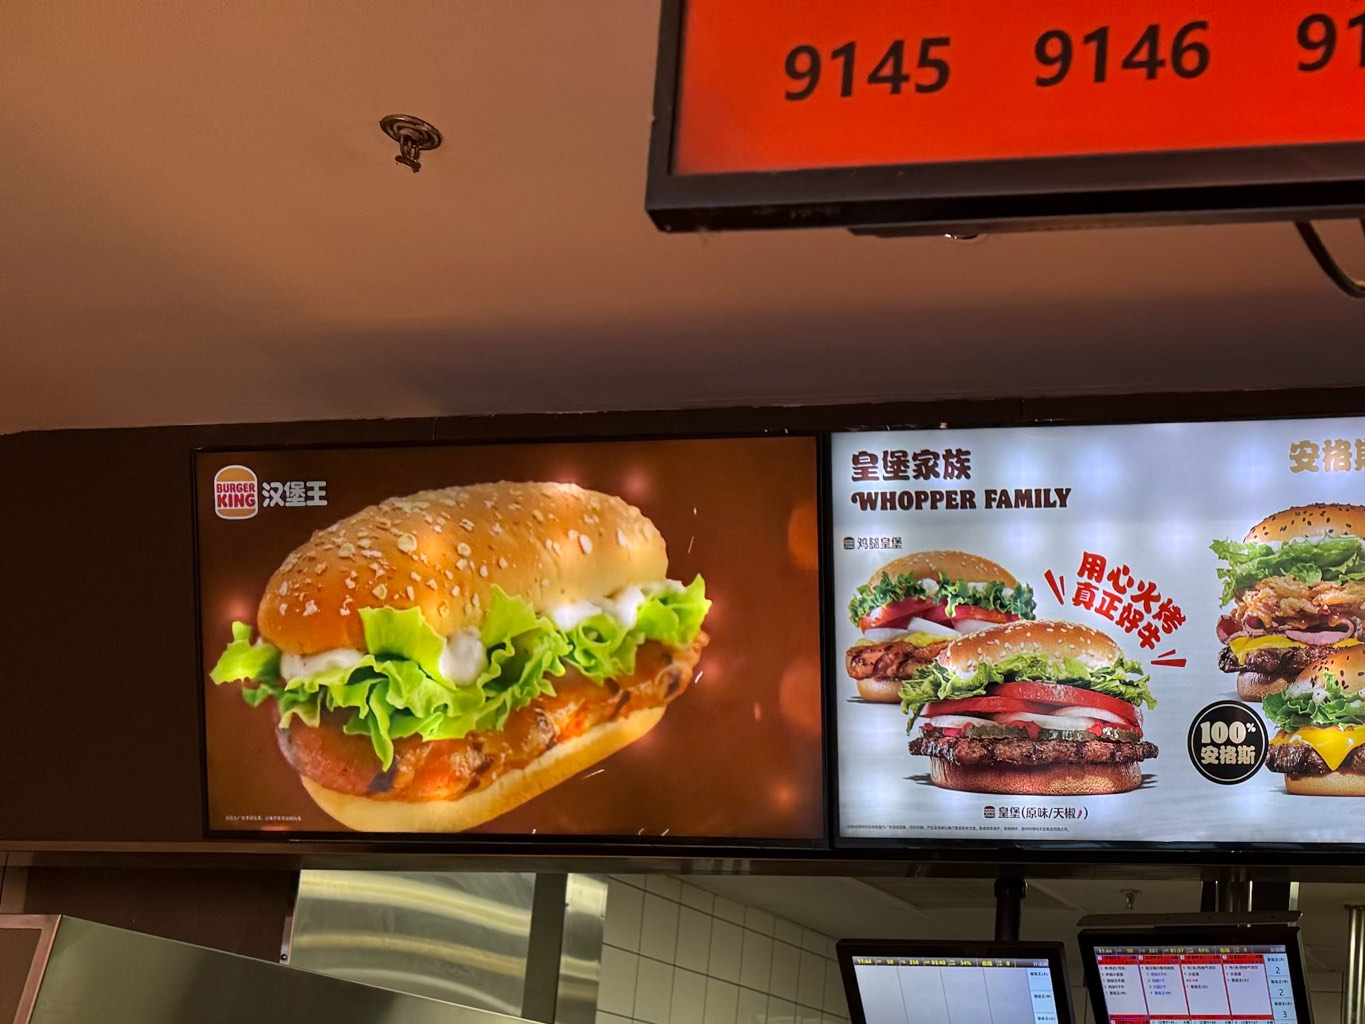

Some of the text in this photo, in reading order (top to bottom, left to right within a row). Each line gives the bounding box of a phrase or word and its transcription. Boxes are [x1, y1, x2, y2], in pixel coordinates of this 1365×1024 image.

[784, 36, 951, 100] 9145
[1034, 20, 1210, 86] 9146
[851, 448, 972, 482] 皇堡家族
[216, 483, 256, 493] BURGER
[262, 481, 328, 508] 汉堡王
[851, 488, 1072, 511] WHOPPER FAMILY
[217, 494, 256, 507] KING
[1077, 551, 1187, 634] 用心火烤
[1200, 721, 1257, 744] 100%
[1201, 745, 1256, 765] 安格斯
